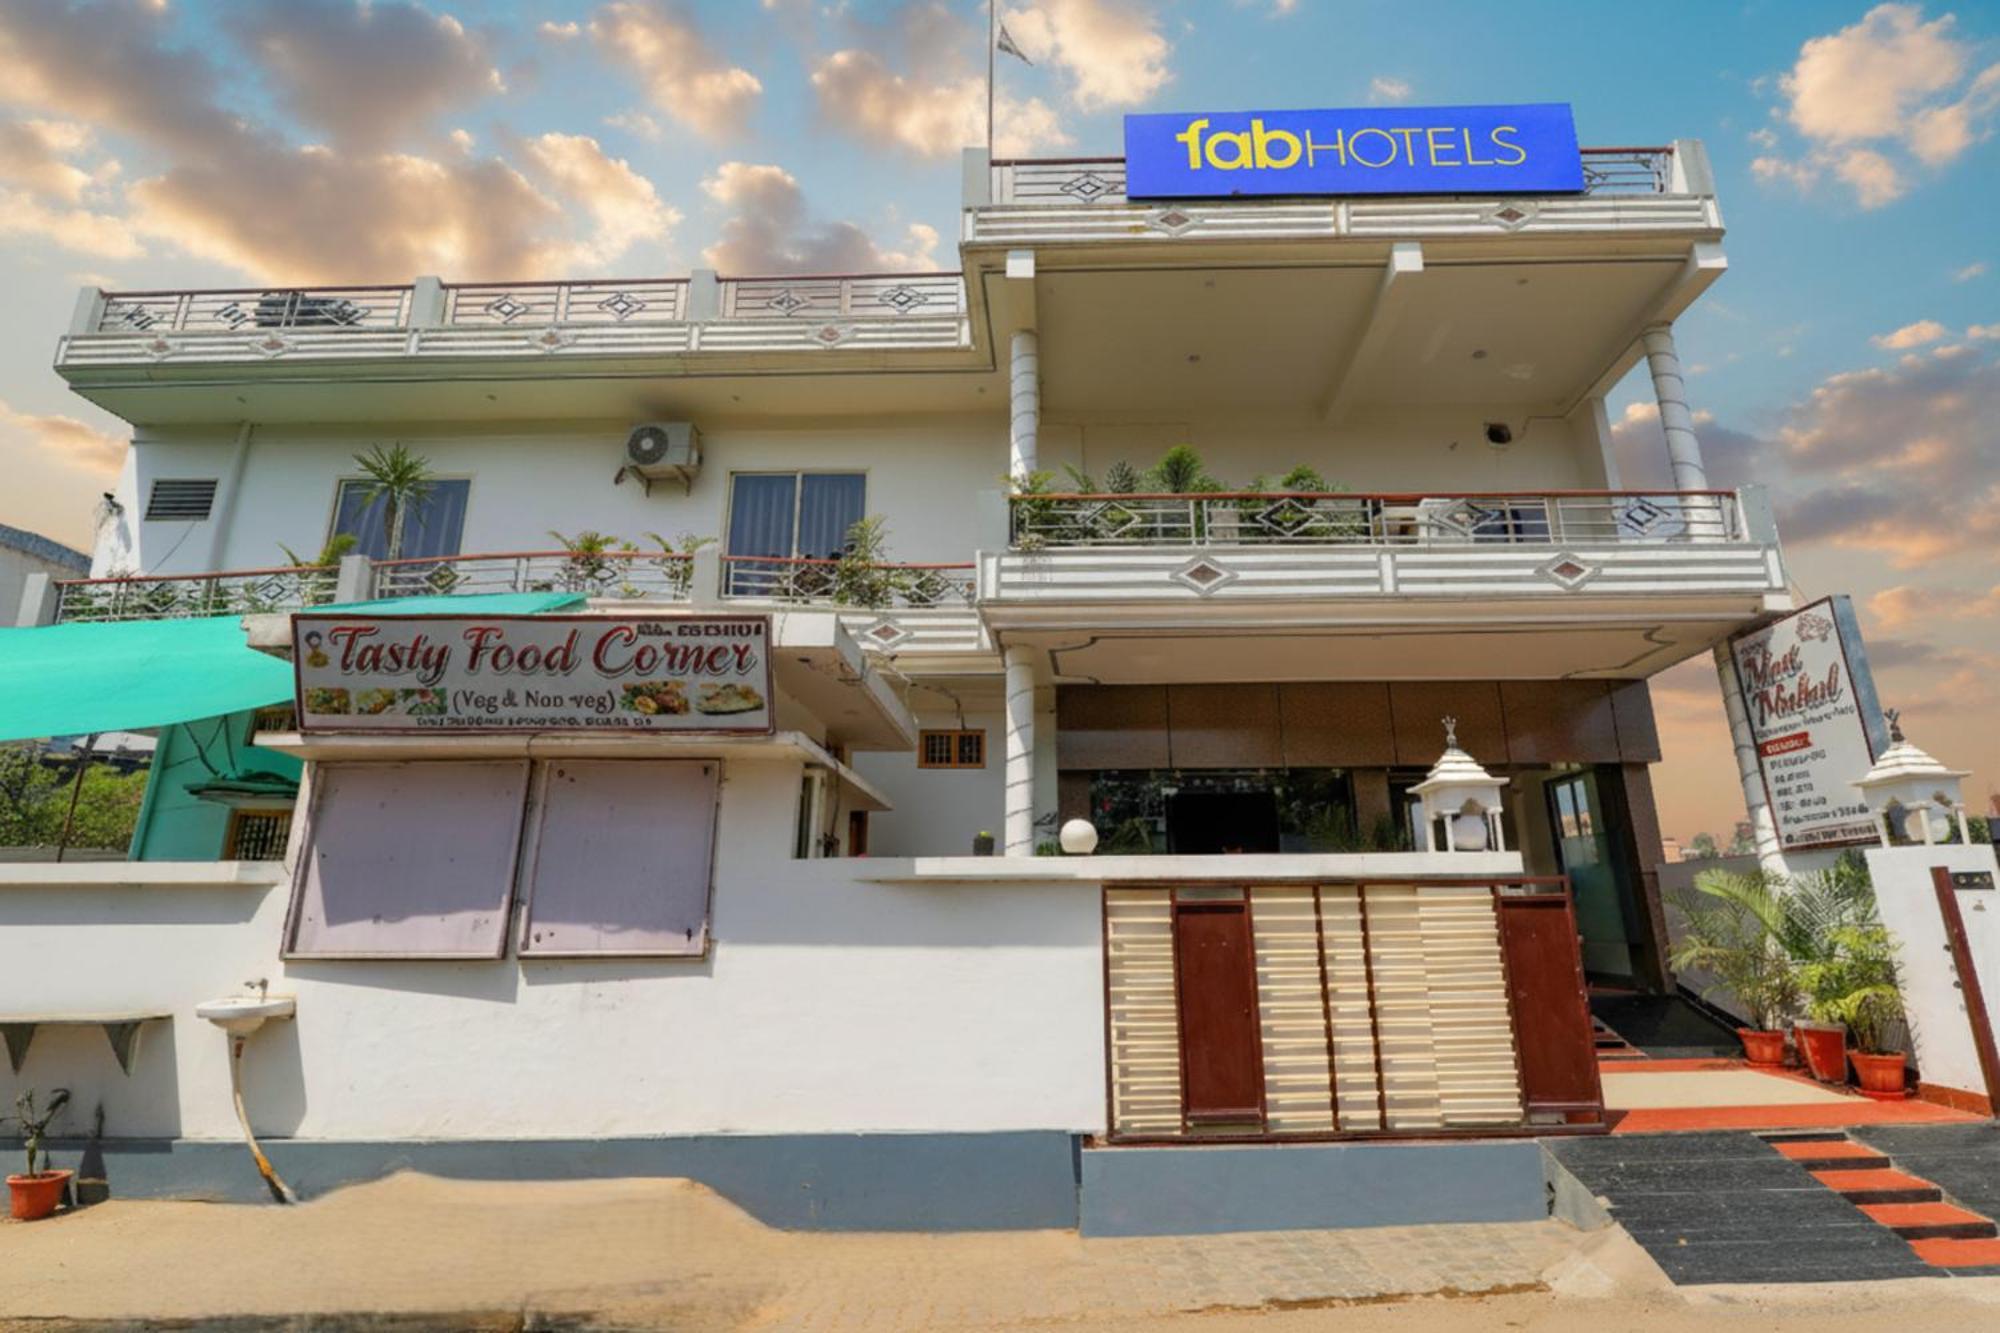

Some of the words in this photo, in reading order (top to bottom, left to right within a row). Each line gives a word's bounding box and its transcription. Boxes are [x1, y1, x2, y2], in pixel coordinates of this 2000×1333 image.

[328, 625, 450, 687] Tasty
[463, 626, 581, 677] Food
[592, 625, 758, 679] Corner
